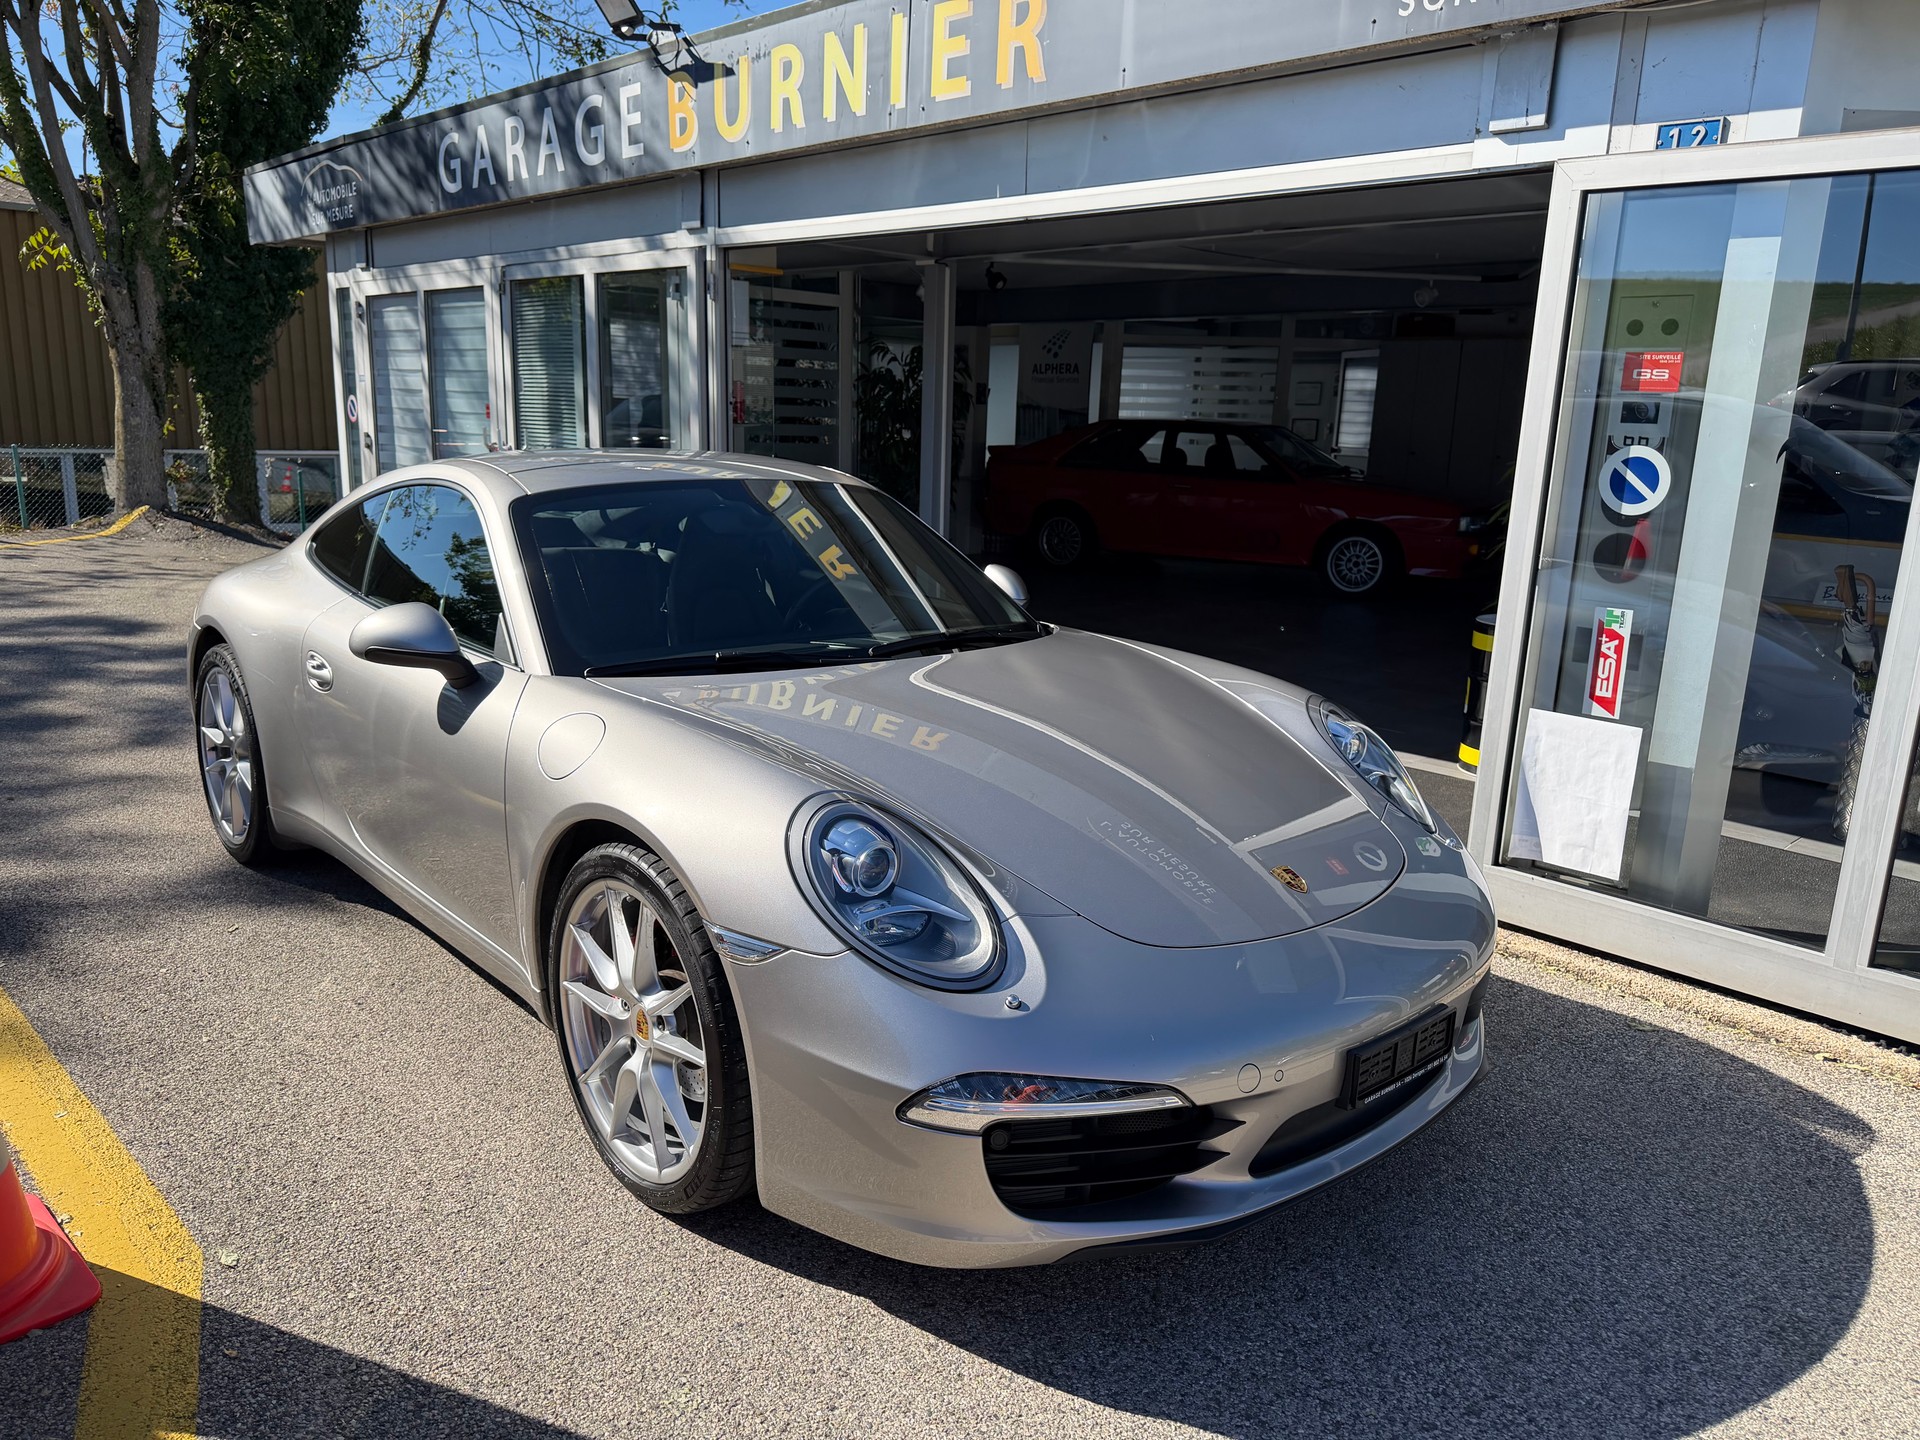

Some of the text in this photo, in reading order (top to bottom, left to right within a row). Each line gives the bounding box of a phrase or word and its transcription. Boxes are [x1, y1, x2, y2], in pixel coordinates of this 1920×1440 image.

[437, 0, 1048, 196] GARAGE BURNIER
[1669, 125, 1706, 149] 12
[312, 204, 354, 226] SUR MESURE
[1032, 362, 1080, 375] ALPHERA
[1633, 368, 1669, 379] GS
